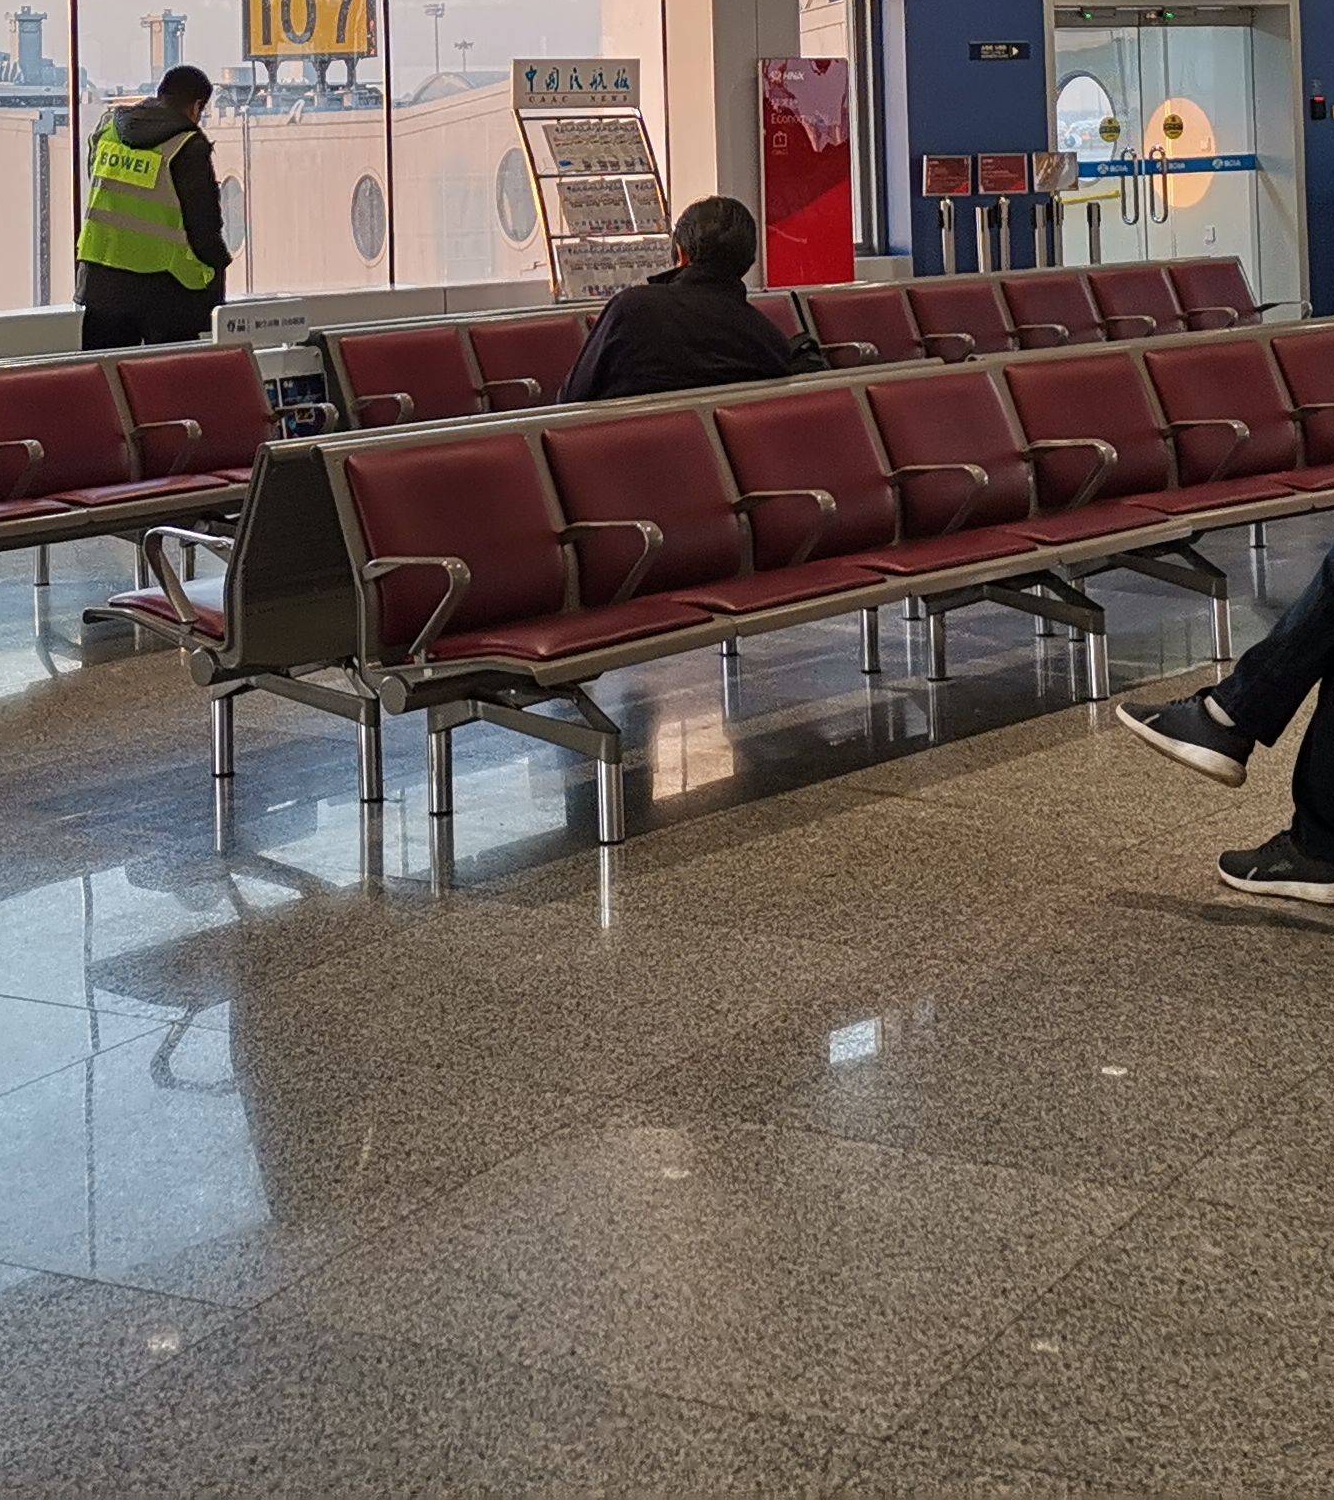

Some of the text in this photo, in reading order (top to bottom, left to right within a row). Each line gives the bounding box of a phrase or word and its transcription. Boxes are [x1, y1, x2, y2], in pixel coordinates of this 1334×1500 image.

[528, 93, 629, 105] CAAC NEWS
[101, 152, 151, 175] BOWEI
